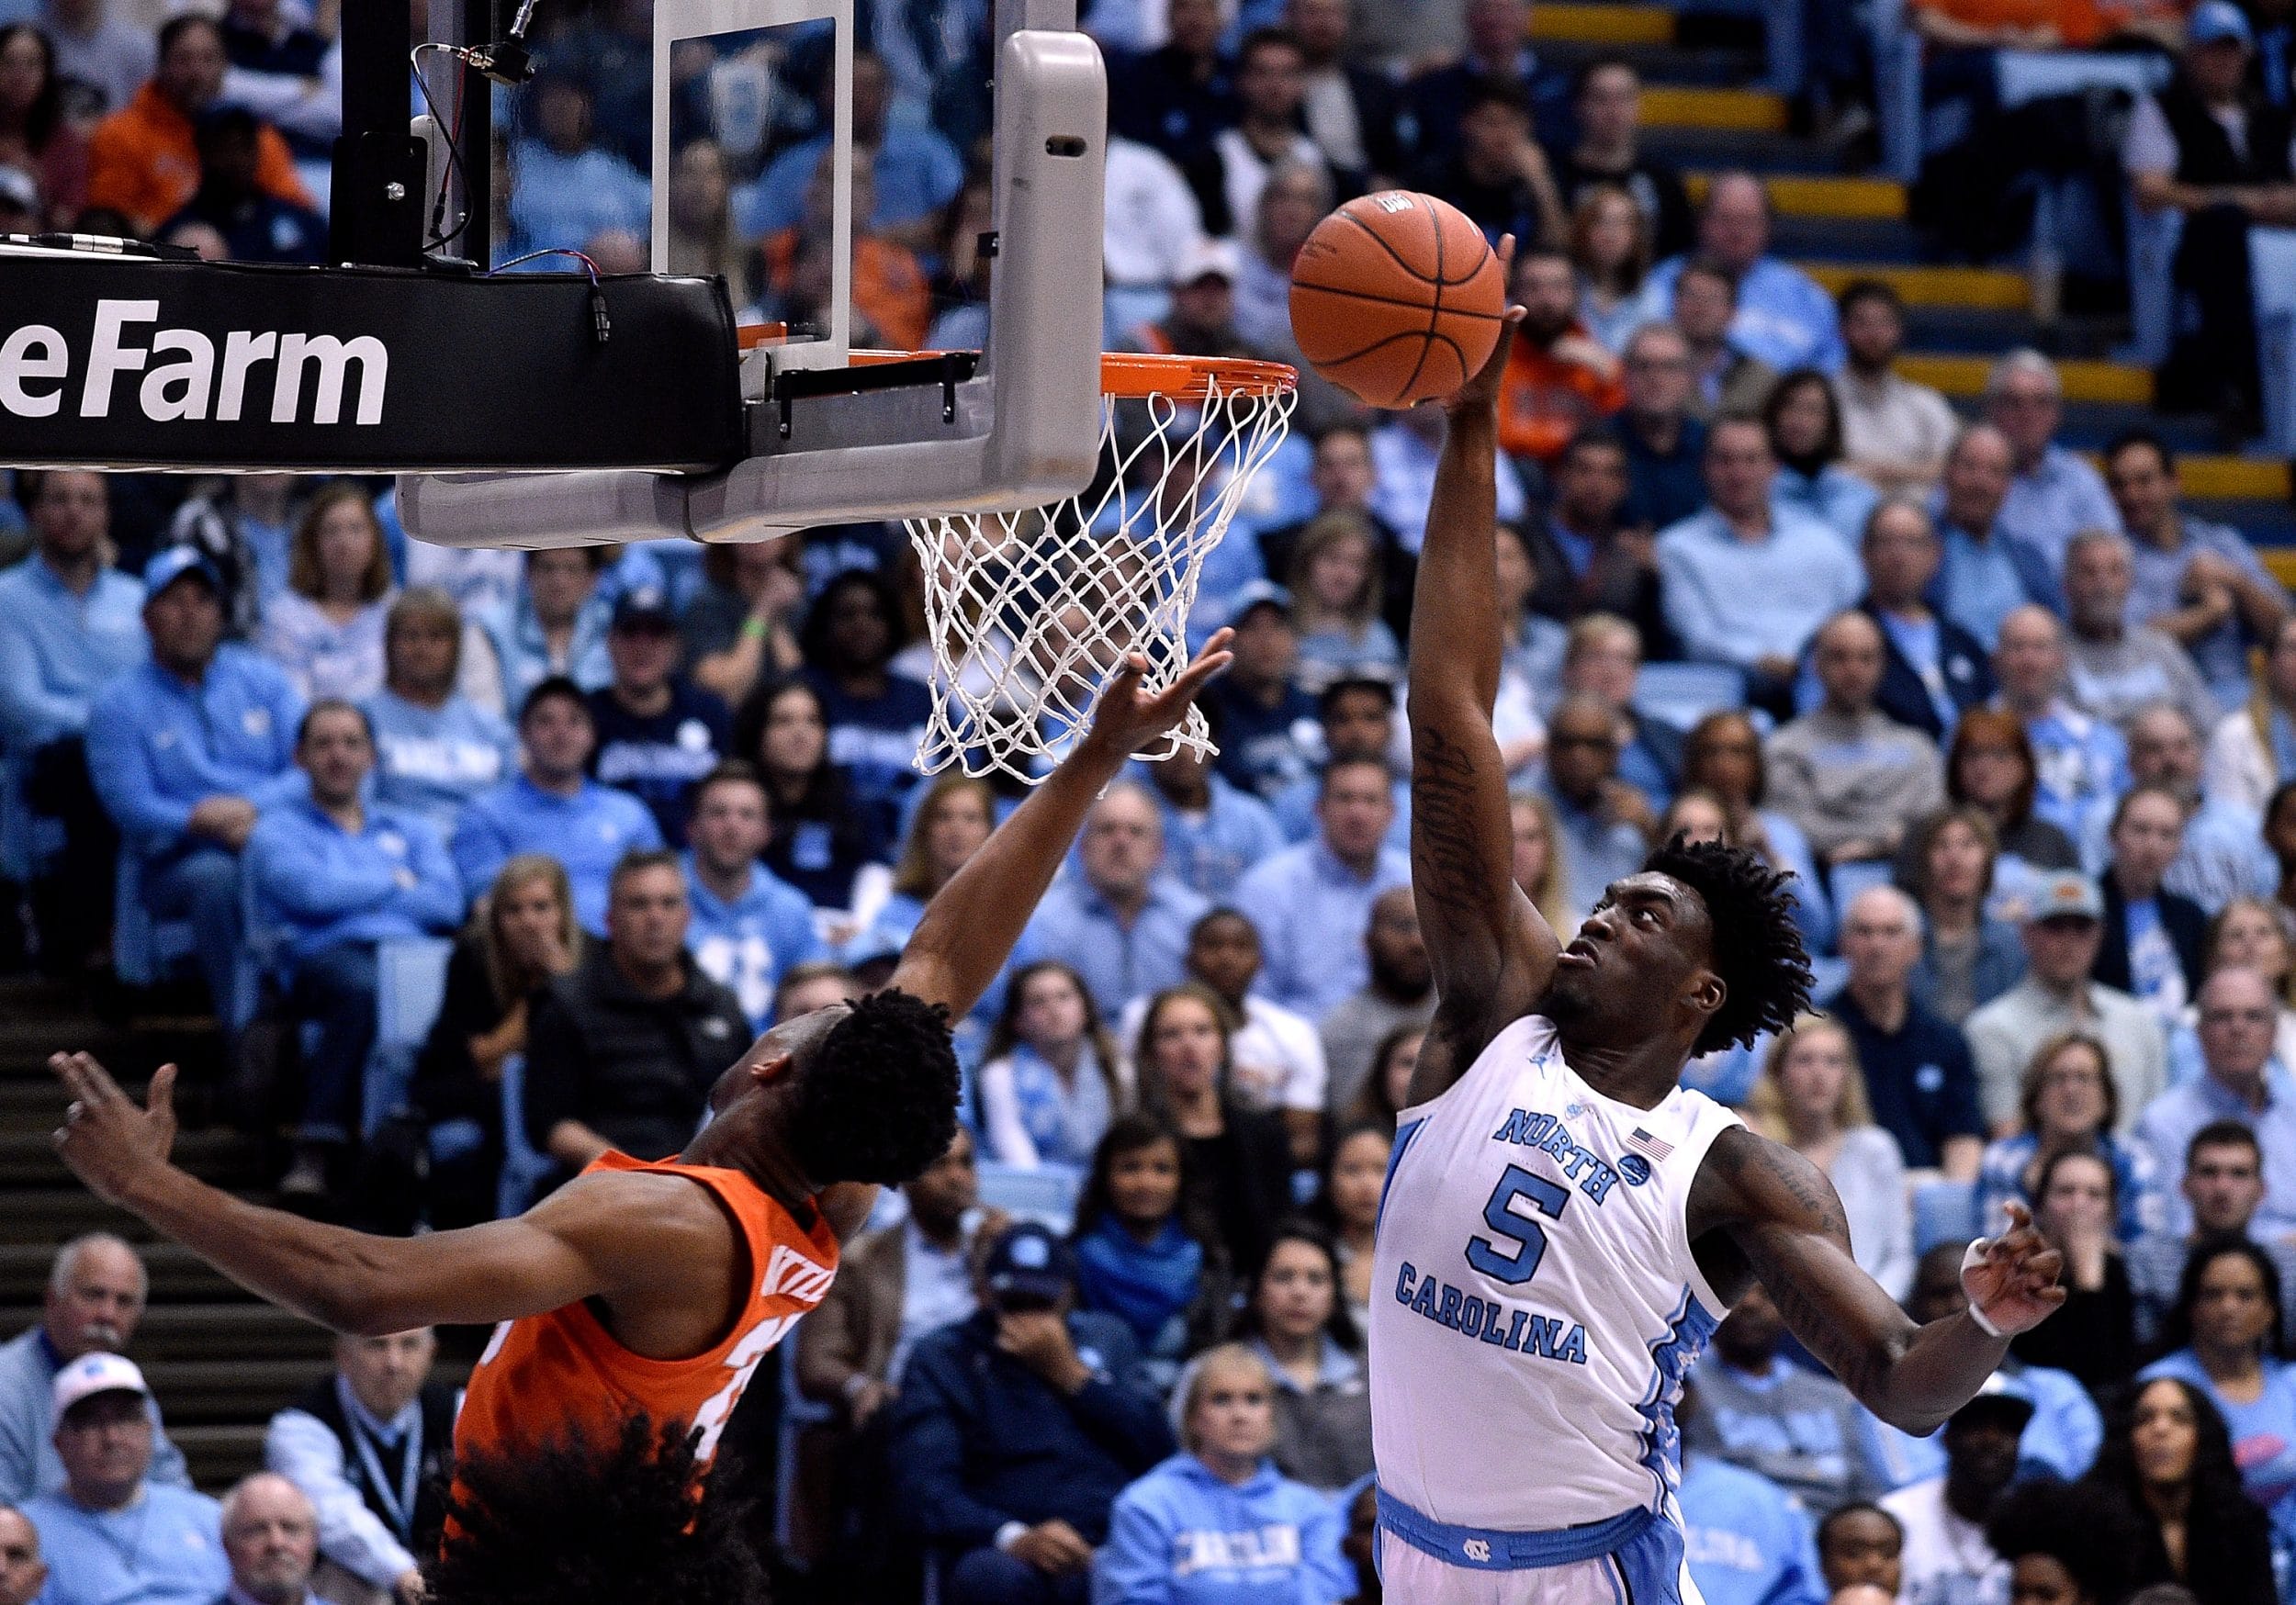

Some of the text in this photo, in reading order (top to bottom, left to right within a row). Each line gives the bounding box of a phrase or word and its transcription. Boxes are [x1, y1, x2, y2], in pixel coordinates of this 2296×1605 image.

[1493, 1108, 1619, 1206] NORTH
[1466, 1163, 1570, 1285] 5
[1396, 1261, 1587, 1364] CAROLINA
